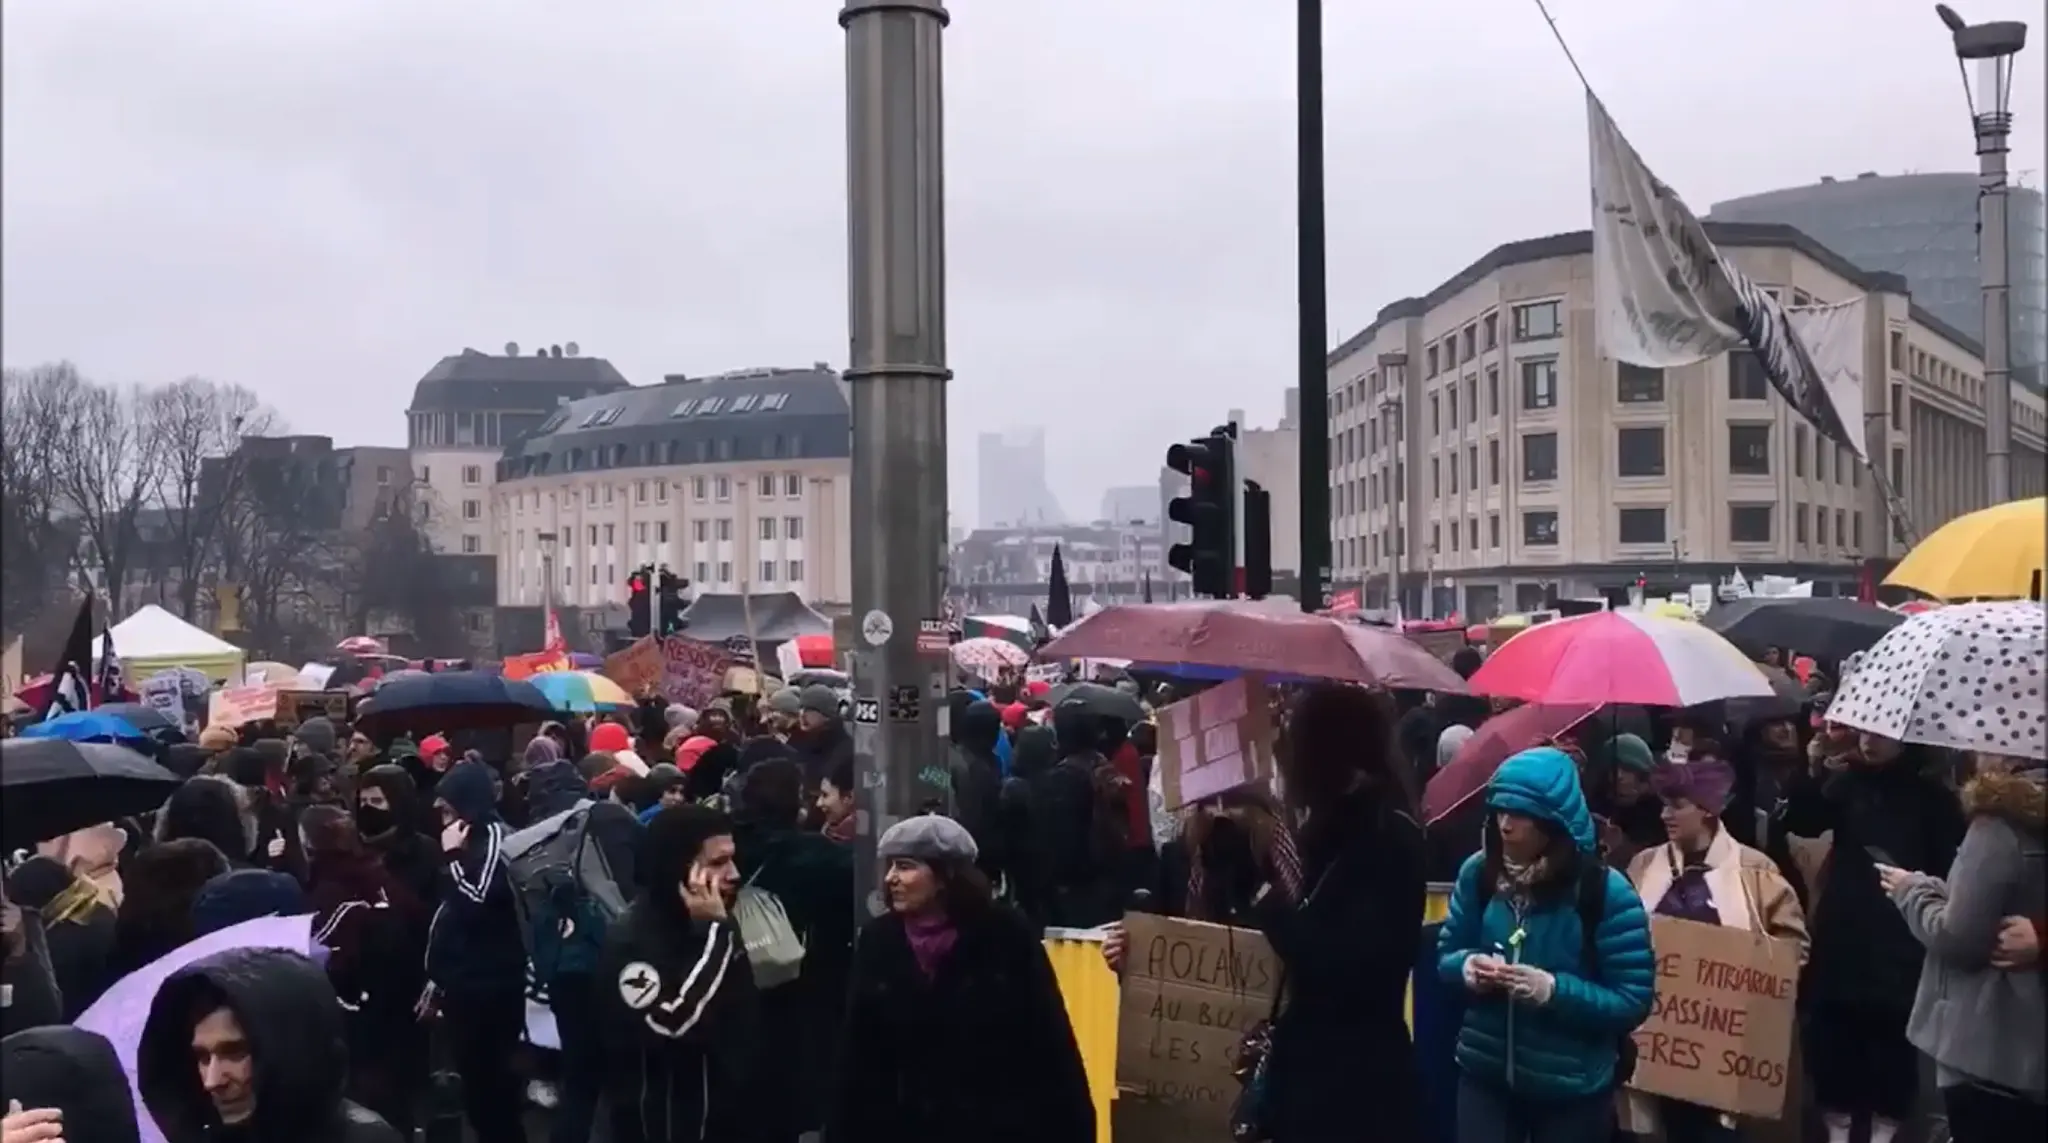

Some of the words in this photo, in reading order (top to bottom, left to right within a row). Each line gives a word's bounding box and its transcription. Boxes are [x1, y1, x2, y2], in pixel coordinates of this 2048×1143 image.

[1151, 993, 1182, 1023] AU
[1150, 1037, 1201, 1063] LES
[1717, 1049, 1785, 1088] SOLOS
